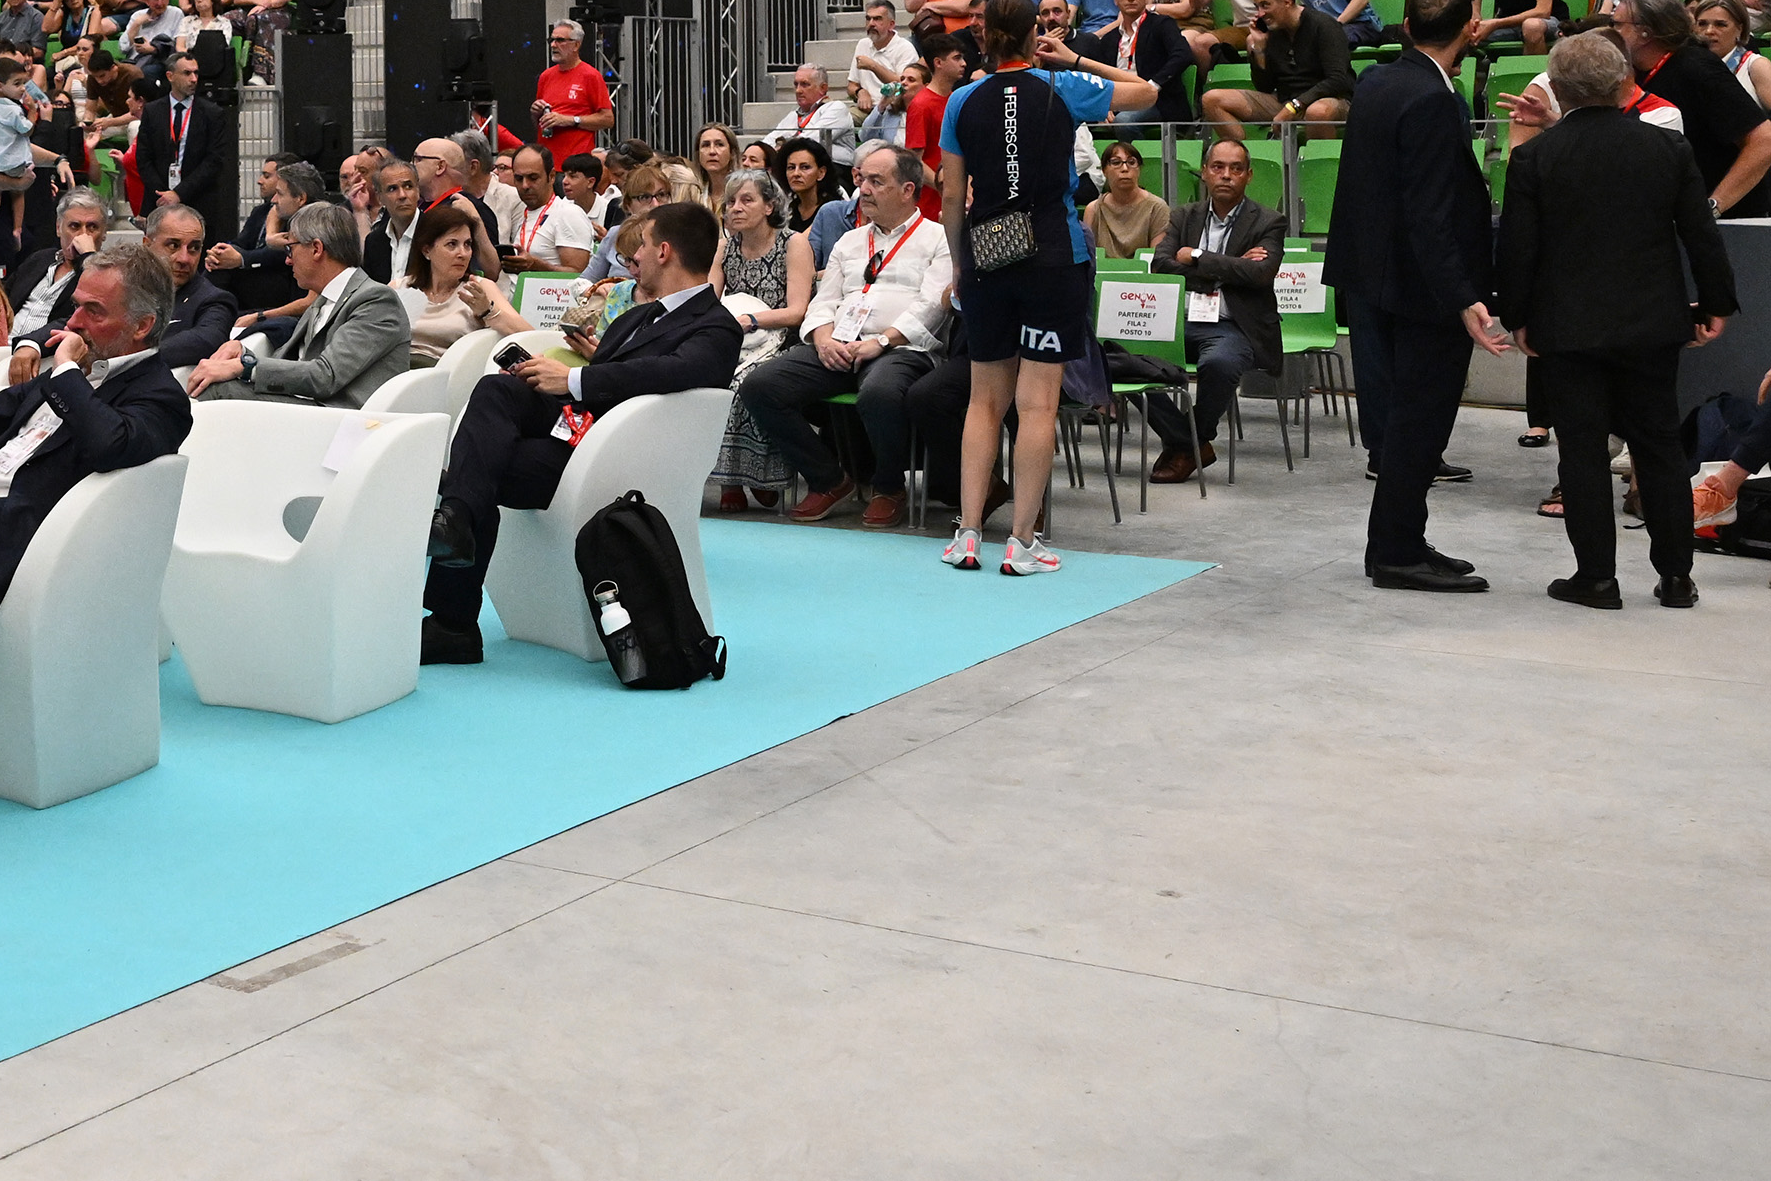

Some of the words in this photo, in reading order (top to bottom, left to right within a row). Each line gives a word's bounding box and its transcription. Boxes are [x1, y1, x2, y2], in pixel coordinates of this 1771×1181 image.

[1004, 94, 1019, 200] FEDERSCHERMA
[1118, 310, 1151, 319] PARTERRE
[1020, 324, 1062, 353] ITA
[1120, 328, 1143, 336] POSTO
